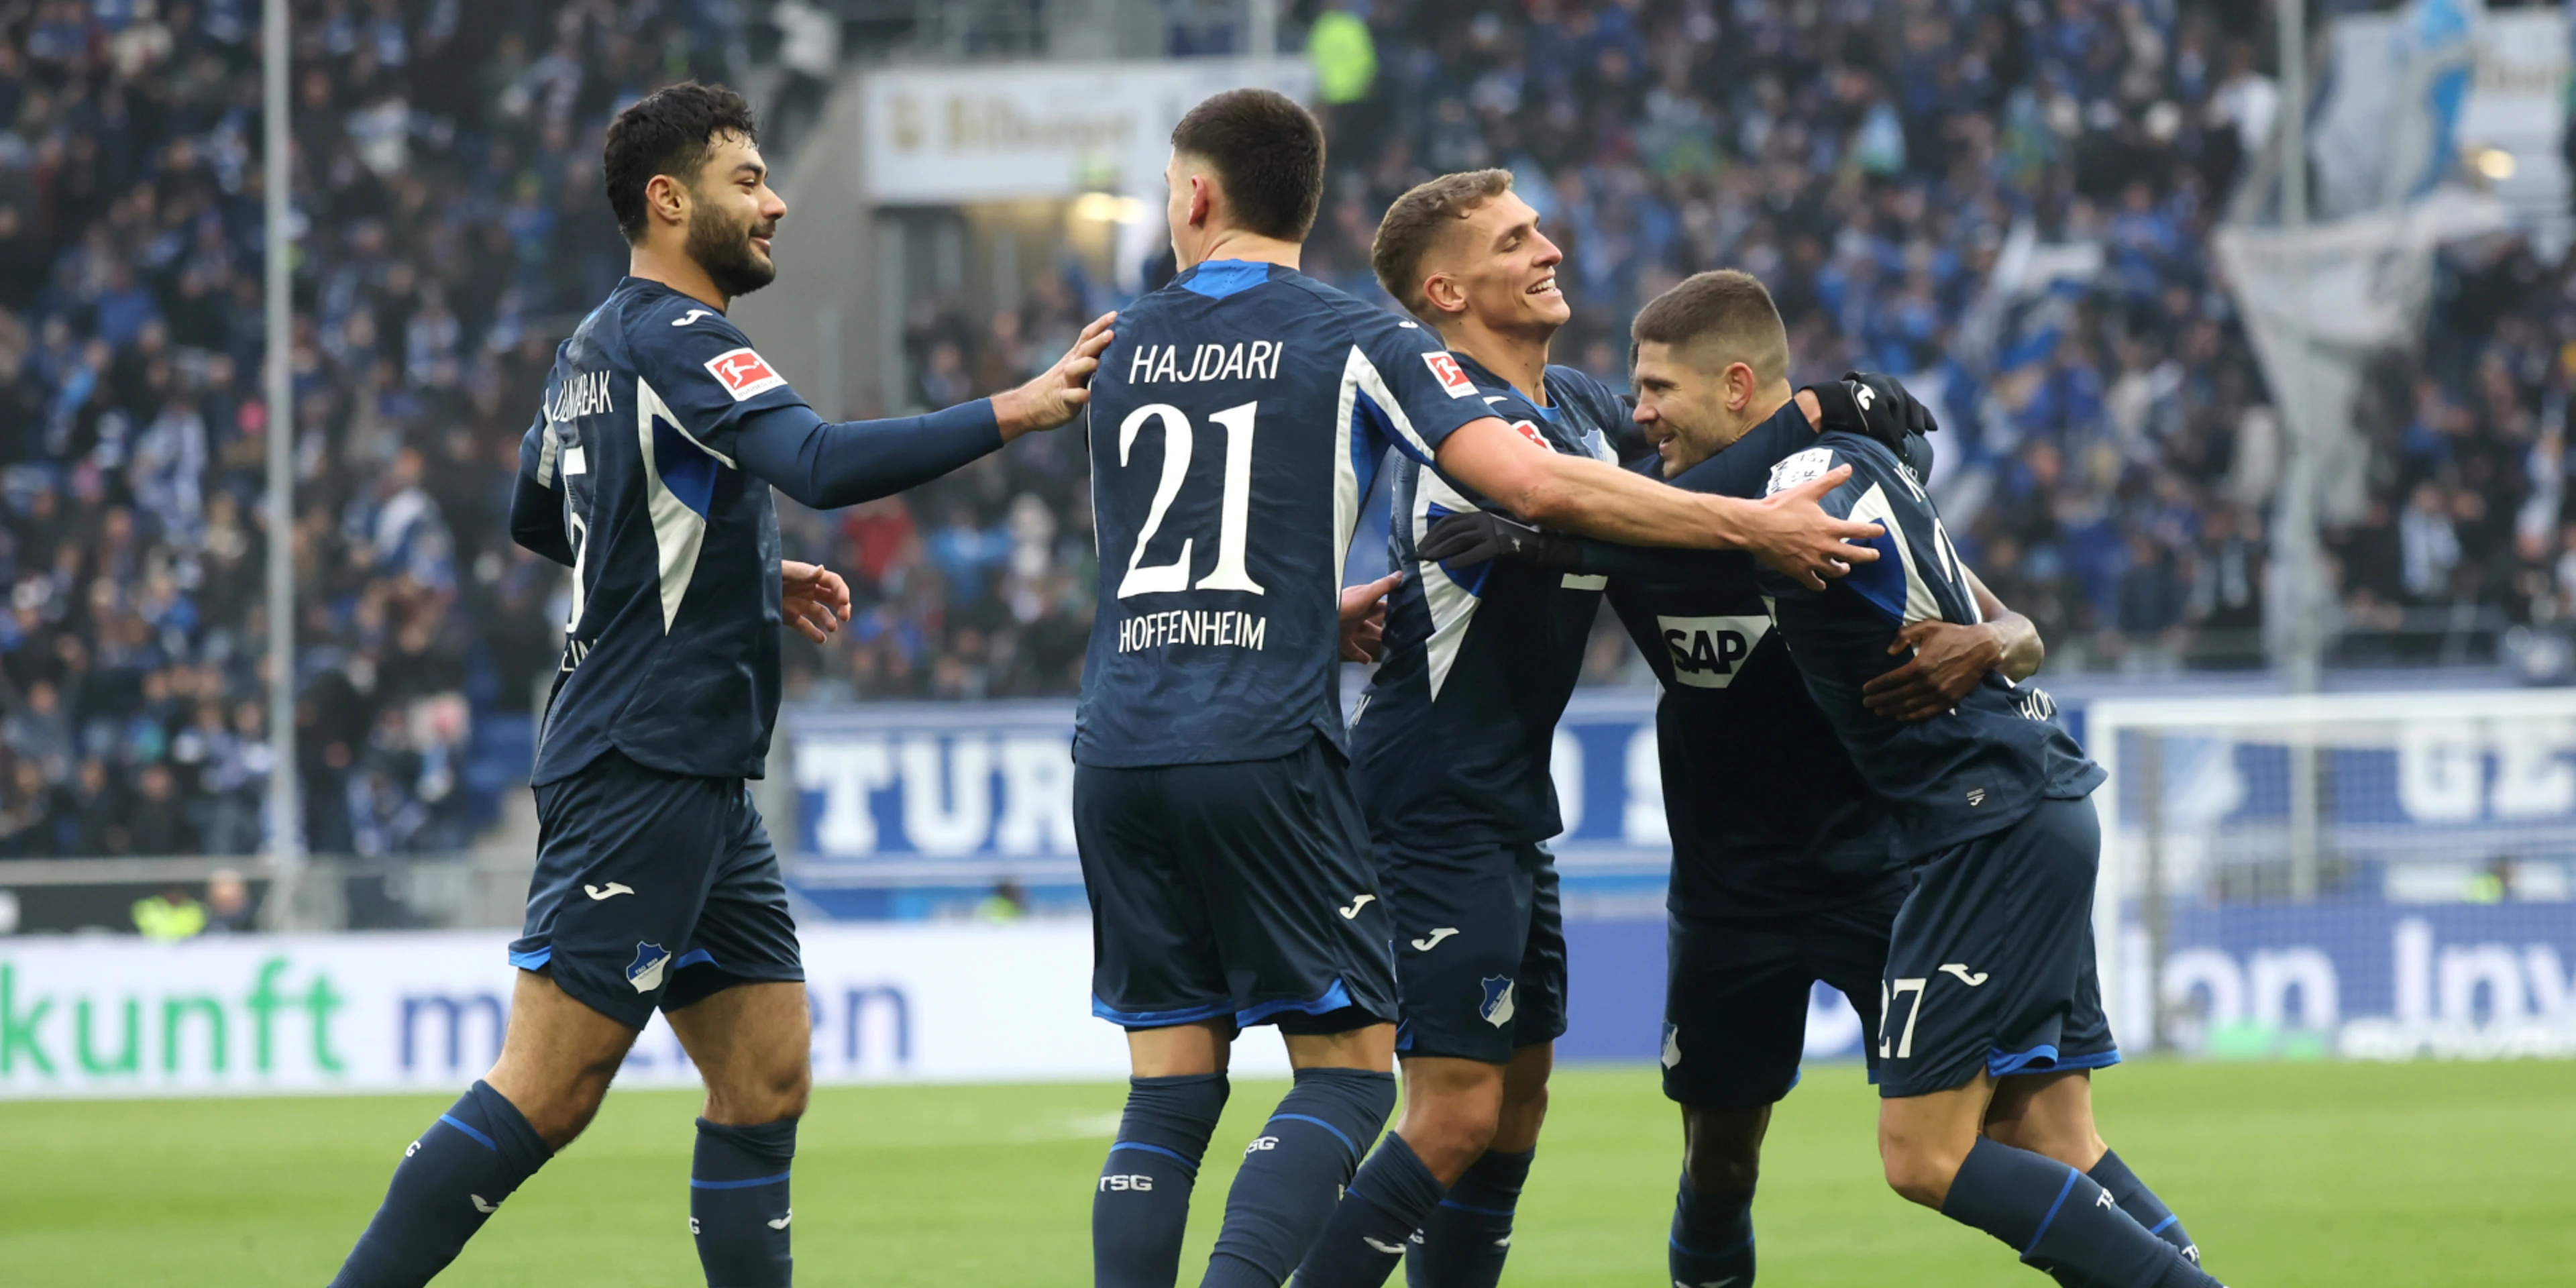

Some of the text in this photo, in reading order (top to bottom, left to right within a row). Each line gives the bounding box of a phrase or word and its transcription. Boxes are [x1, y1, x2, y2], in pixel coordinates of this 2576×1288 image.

[1129, 341, 1283, 384] HAJDARI
[1118, 400, 1265, 599] 21
[1118, 610, 1266, 653] HOFFENHEIM
[1664, 629, 1748, 675] SAP
[0, 955, 352, 1077] kunft
[1878, 978, 1927, 1059] 27
[1099, 1174, 1153, 1192] TSG
